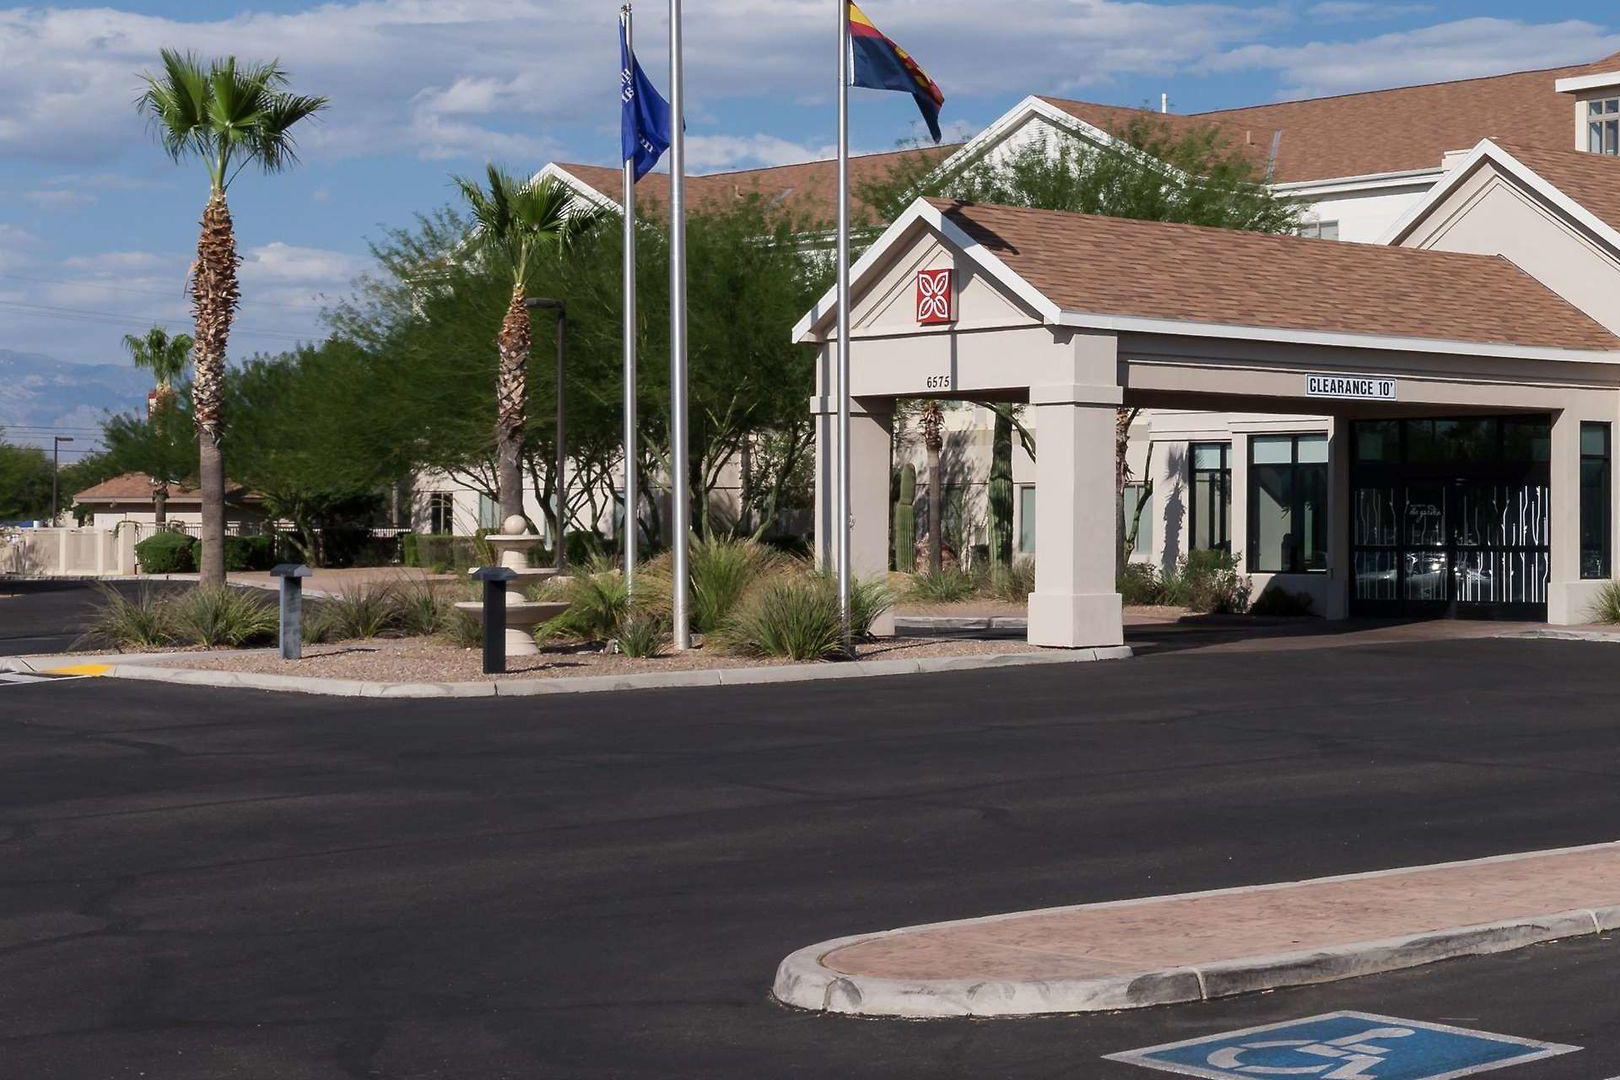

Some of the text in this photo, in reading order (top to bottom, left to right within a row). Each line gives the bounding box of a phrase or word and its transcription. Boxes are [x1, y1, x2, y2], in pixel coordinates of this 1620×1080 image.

[927, 376, 949, 388] 6575
[1309, 377, 1393, 396] CLEARANCE 10'
